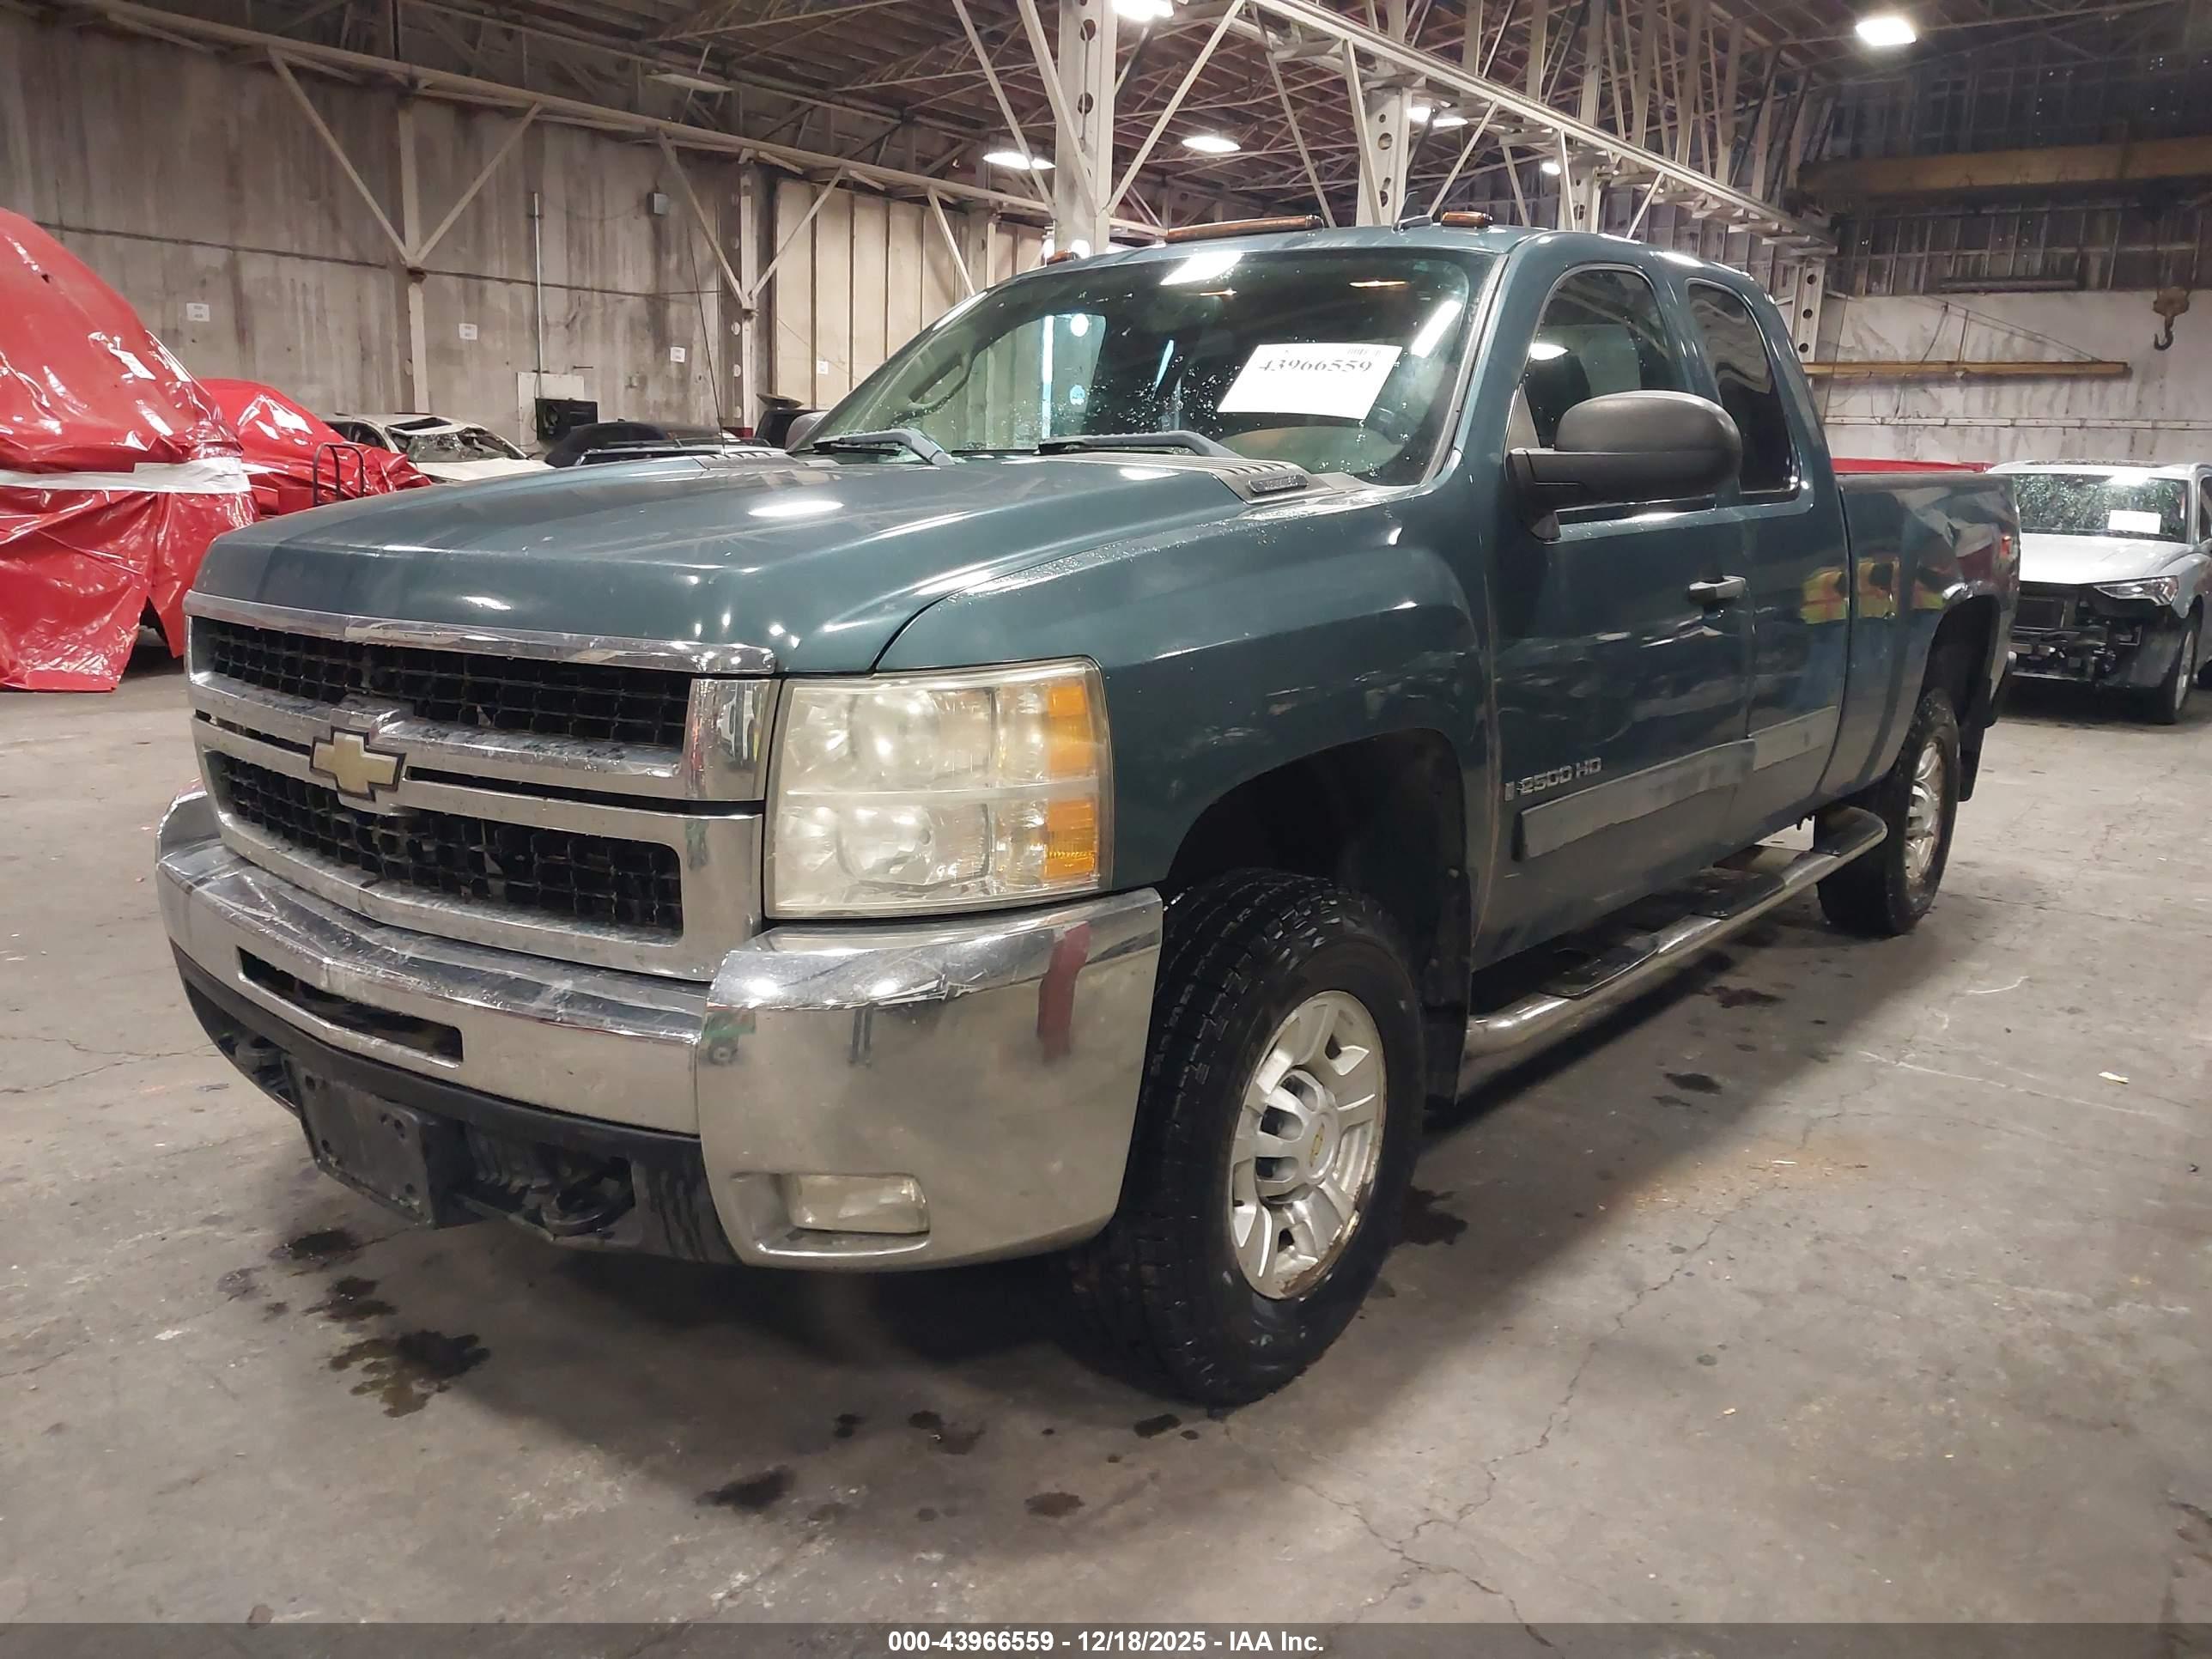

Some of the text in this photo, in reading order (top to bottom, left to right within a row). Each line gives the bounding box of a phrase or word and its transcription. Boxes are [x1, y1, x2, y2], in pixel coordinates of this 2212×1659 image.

[1259, 359, 1372, 372] 43966559
[1516, 757, 1601, 796] 2500 HD
